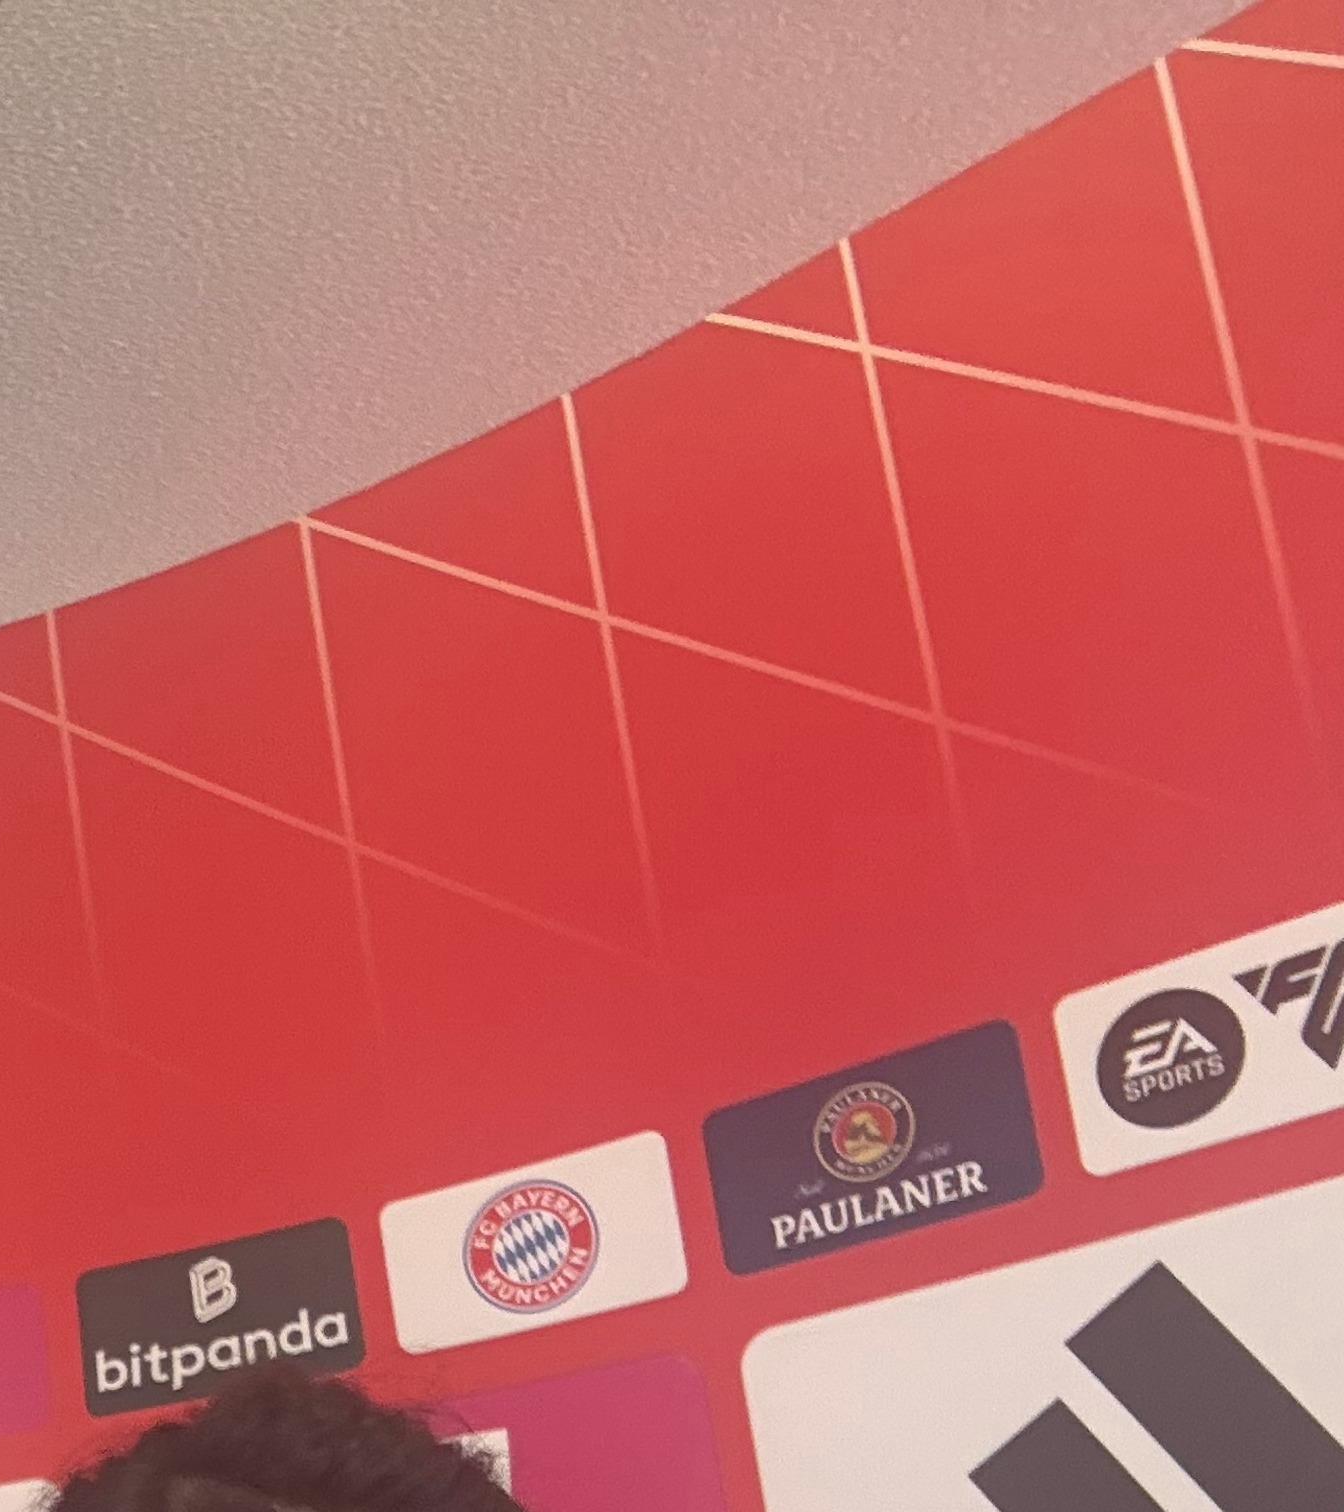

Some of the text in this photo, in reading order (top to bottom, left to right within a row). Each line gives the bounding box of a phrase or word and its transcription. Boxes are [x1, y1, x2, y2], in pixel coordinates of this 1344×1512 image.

[1123, 1016, 1220, 1080] EA
[1123, 1054, 1227, 1104] SPORTS
[769, 1160, 989, 1250] PAULANER
[95, 1306, 350, 1394] bitpanda
